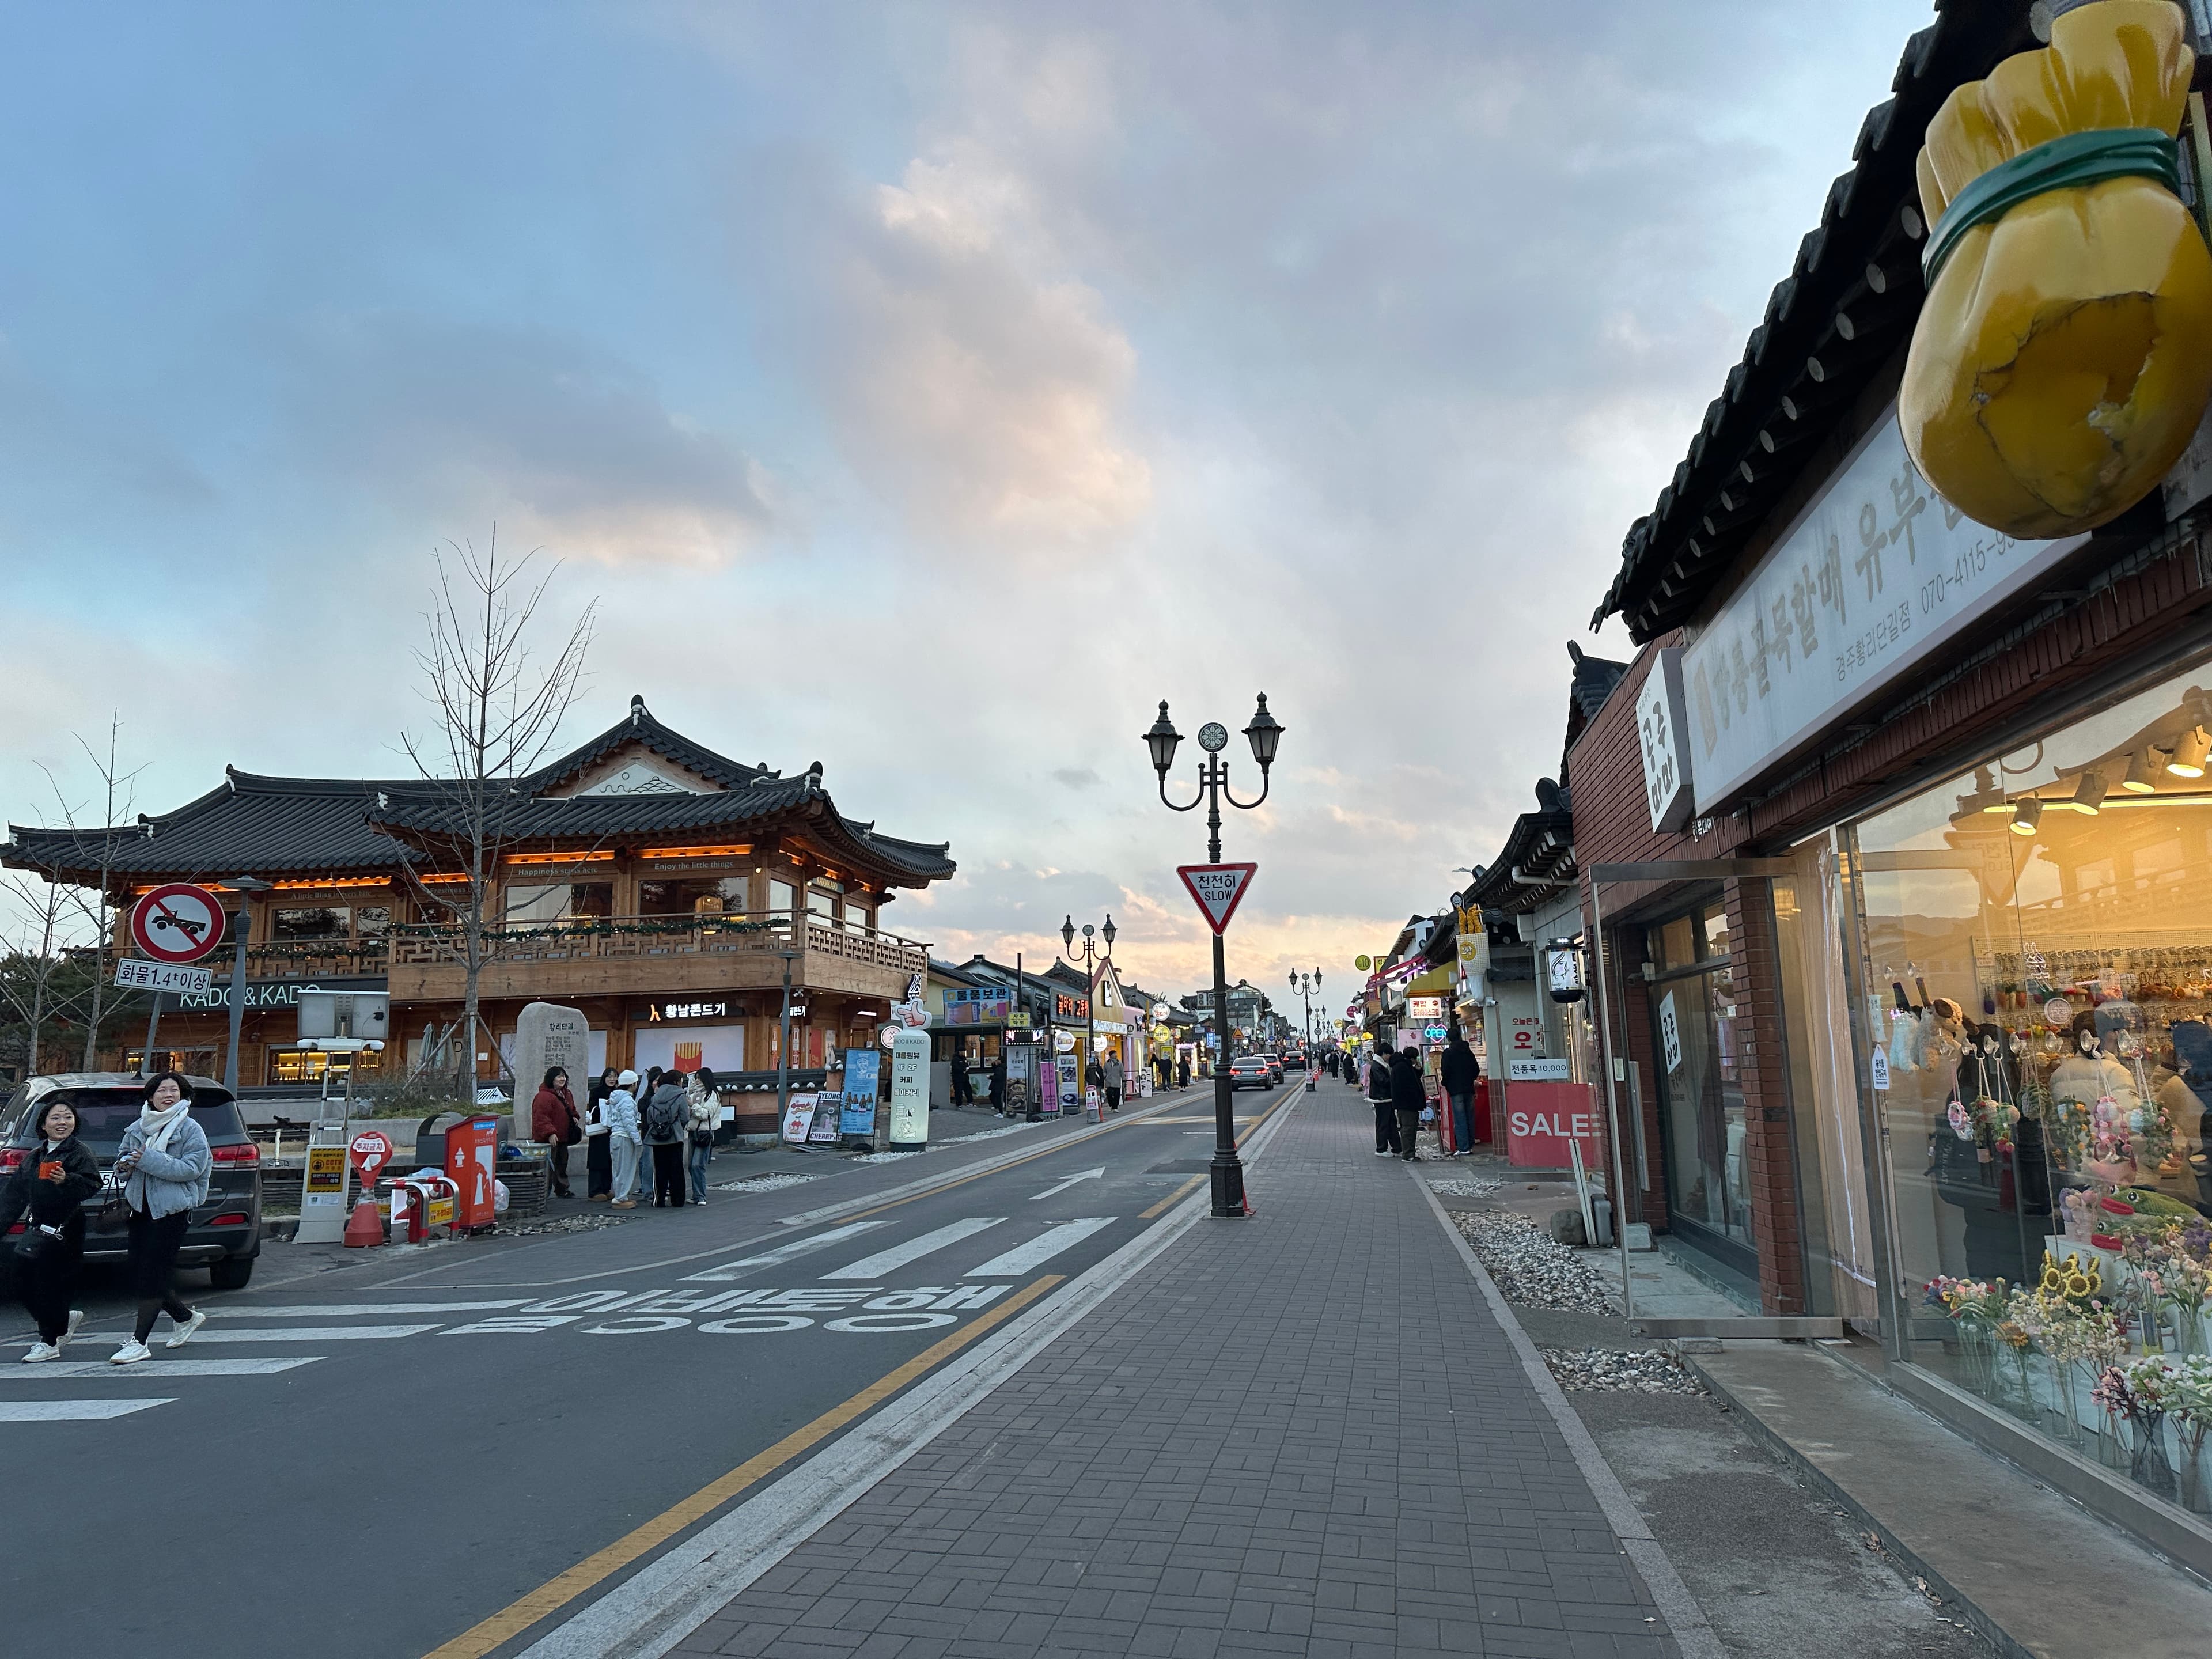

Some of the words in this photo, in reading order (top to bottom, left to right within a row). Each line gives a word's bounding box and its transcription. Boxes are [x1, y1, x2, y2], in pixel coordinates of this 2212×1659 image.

[1836, 600, 1912, 681] 경주황리단길점
[1643, 700, 1666, 774] 공주
[1651, 752, 1673, 815] 마마
[654, 863, 676, 871] Enjoy
[710, 861, 733, 869] things
[518, 868, 559, 876] Happiness
[1198, 874, 1236, 889] 천천히
[1205, 890, 1232, 901] SLOW
[245, 989, 256, 1006] &
[260, 984, 320, 1005] KAD
[1413, 1000, 1427, 1008] 케밥
[665, 1002, 726, 1018] 황남쫀드기
[549, 1022, 574, 1032] 황리단길
[1425, 1028, 1447, 1038] OPEN
[1512, 1065, 1537, 1074] 전품목
[1539, 1065, 1566, 1073] 10,000
[819, 1092, 843, 1100] YEONG
[1510, 1112, 1590, 1137] SALE
